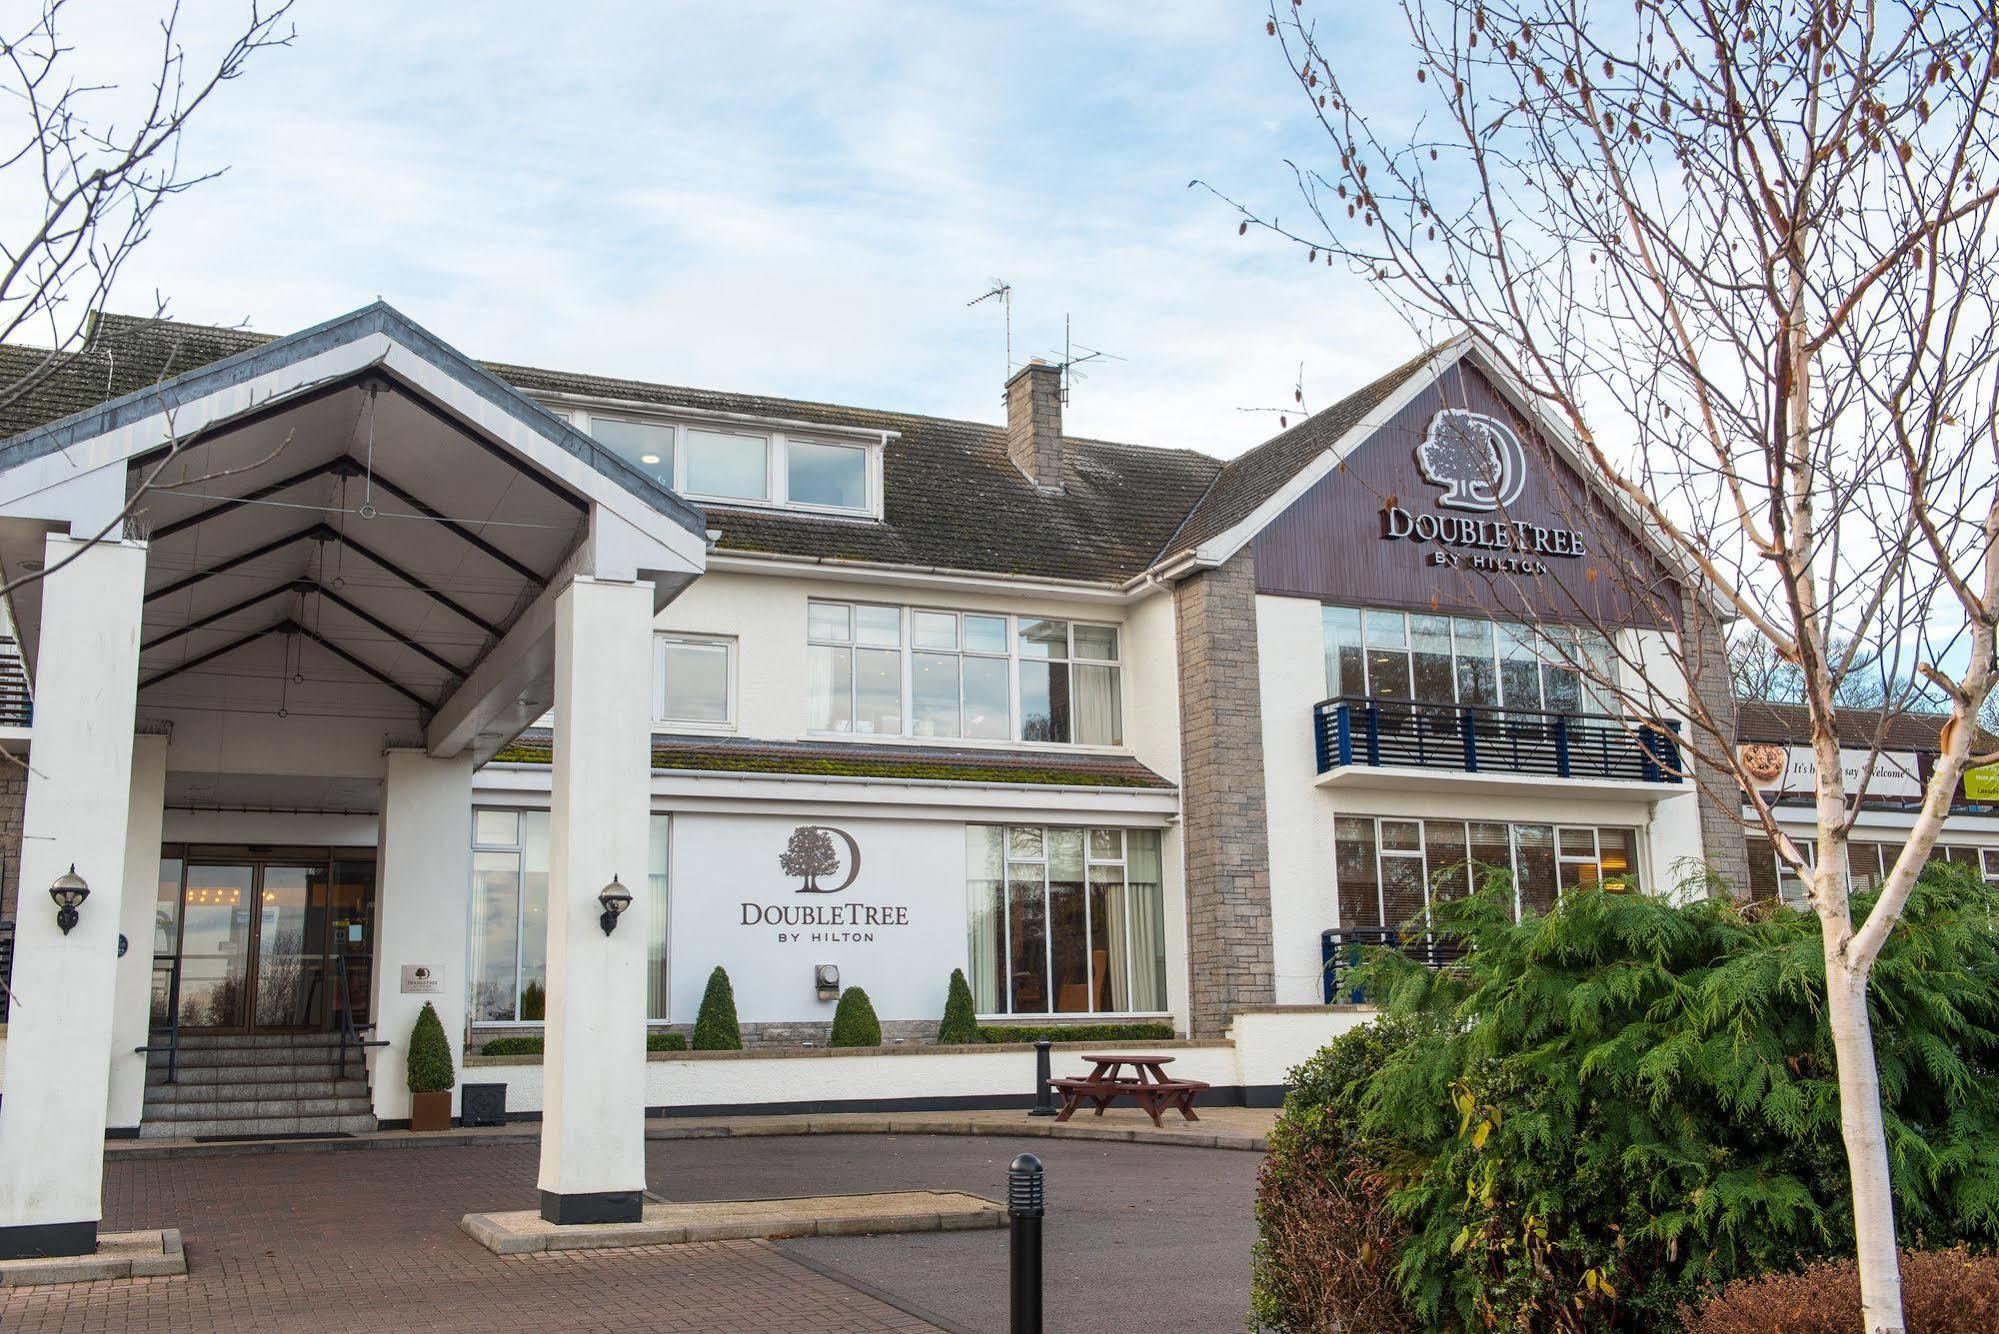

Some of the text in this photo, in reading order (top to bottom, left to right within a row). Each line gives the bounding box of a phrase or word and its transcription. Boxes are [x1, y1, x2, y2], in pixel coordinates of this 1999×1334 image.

[1434, 552, 1547, 575] BY HILTON
[1844, 767, 1859, 779] say
[740, 902, 910, 926] DOUBLETREE
[778, 932, 874, 943] BY HILTON
